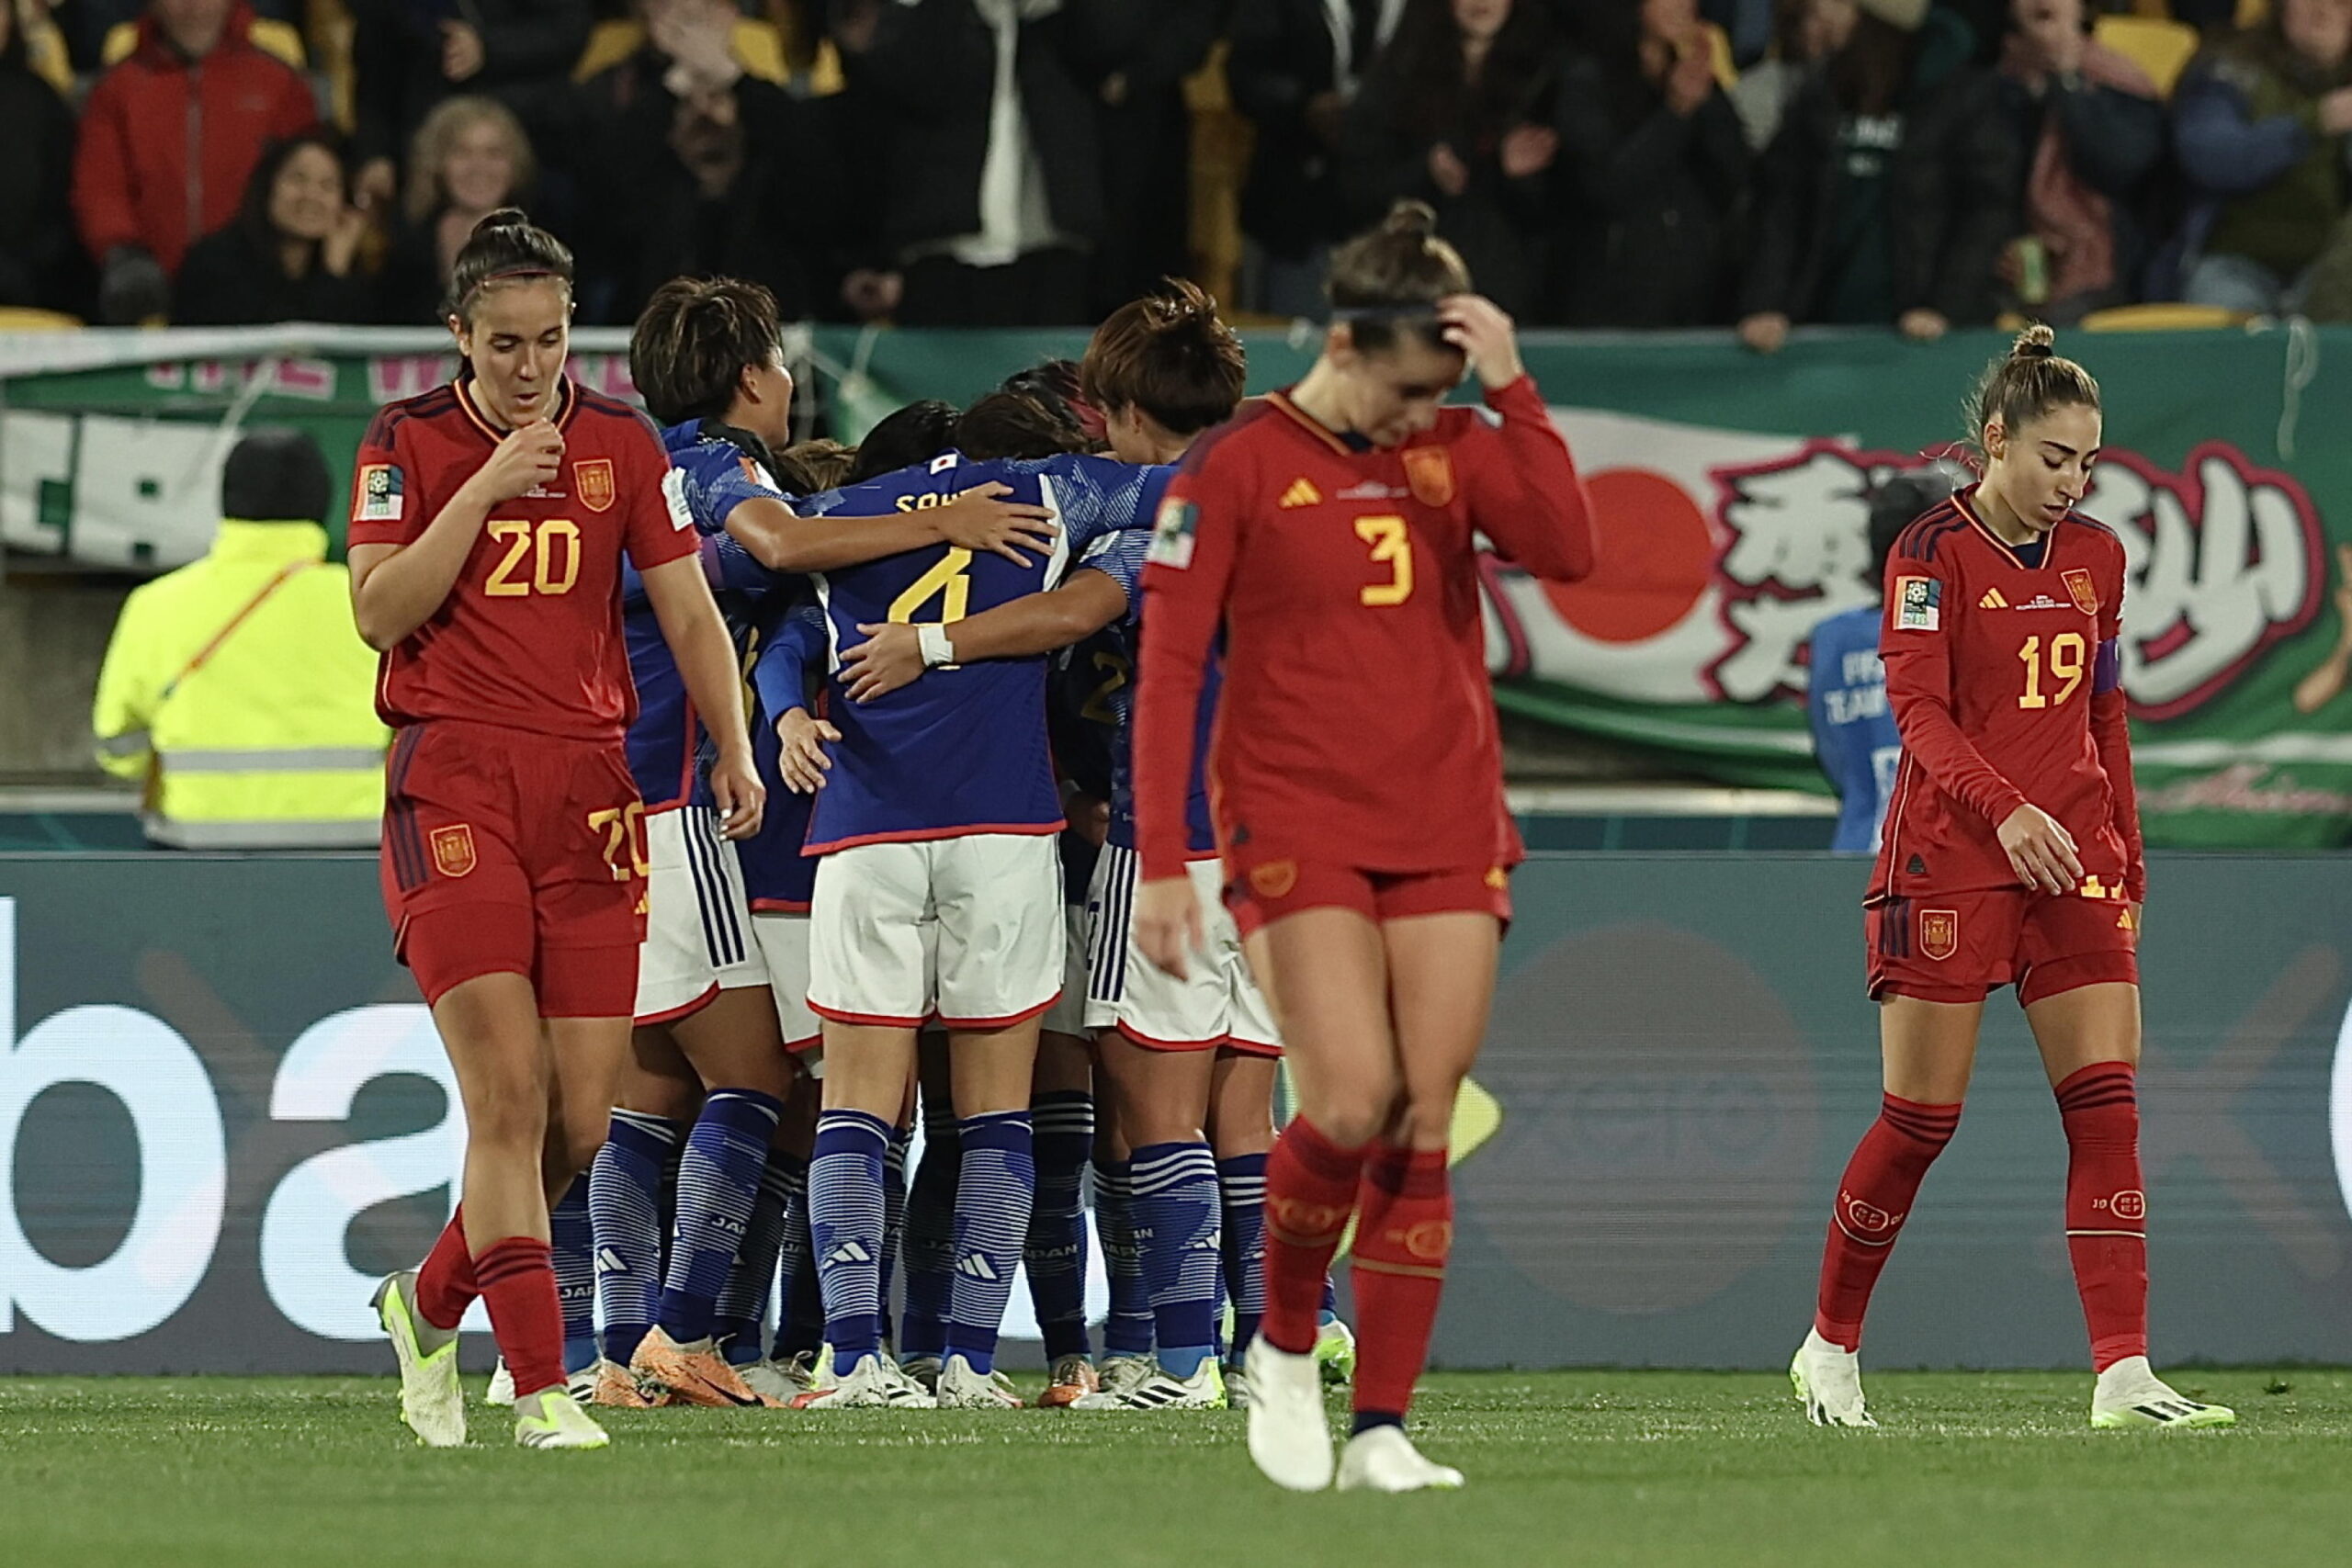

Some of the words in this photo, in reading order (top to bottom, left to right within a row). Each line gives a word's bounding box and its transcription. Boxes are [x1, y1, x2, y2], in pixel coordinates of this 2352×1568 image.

[484, 520, 581, 595] 20
[1354, 515, 1412, 605] 3
[888, 547, 972, 671] 4
[2018, 632, 2086, 708] 19
